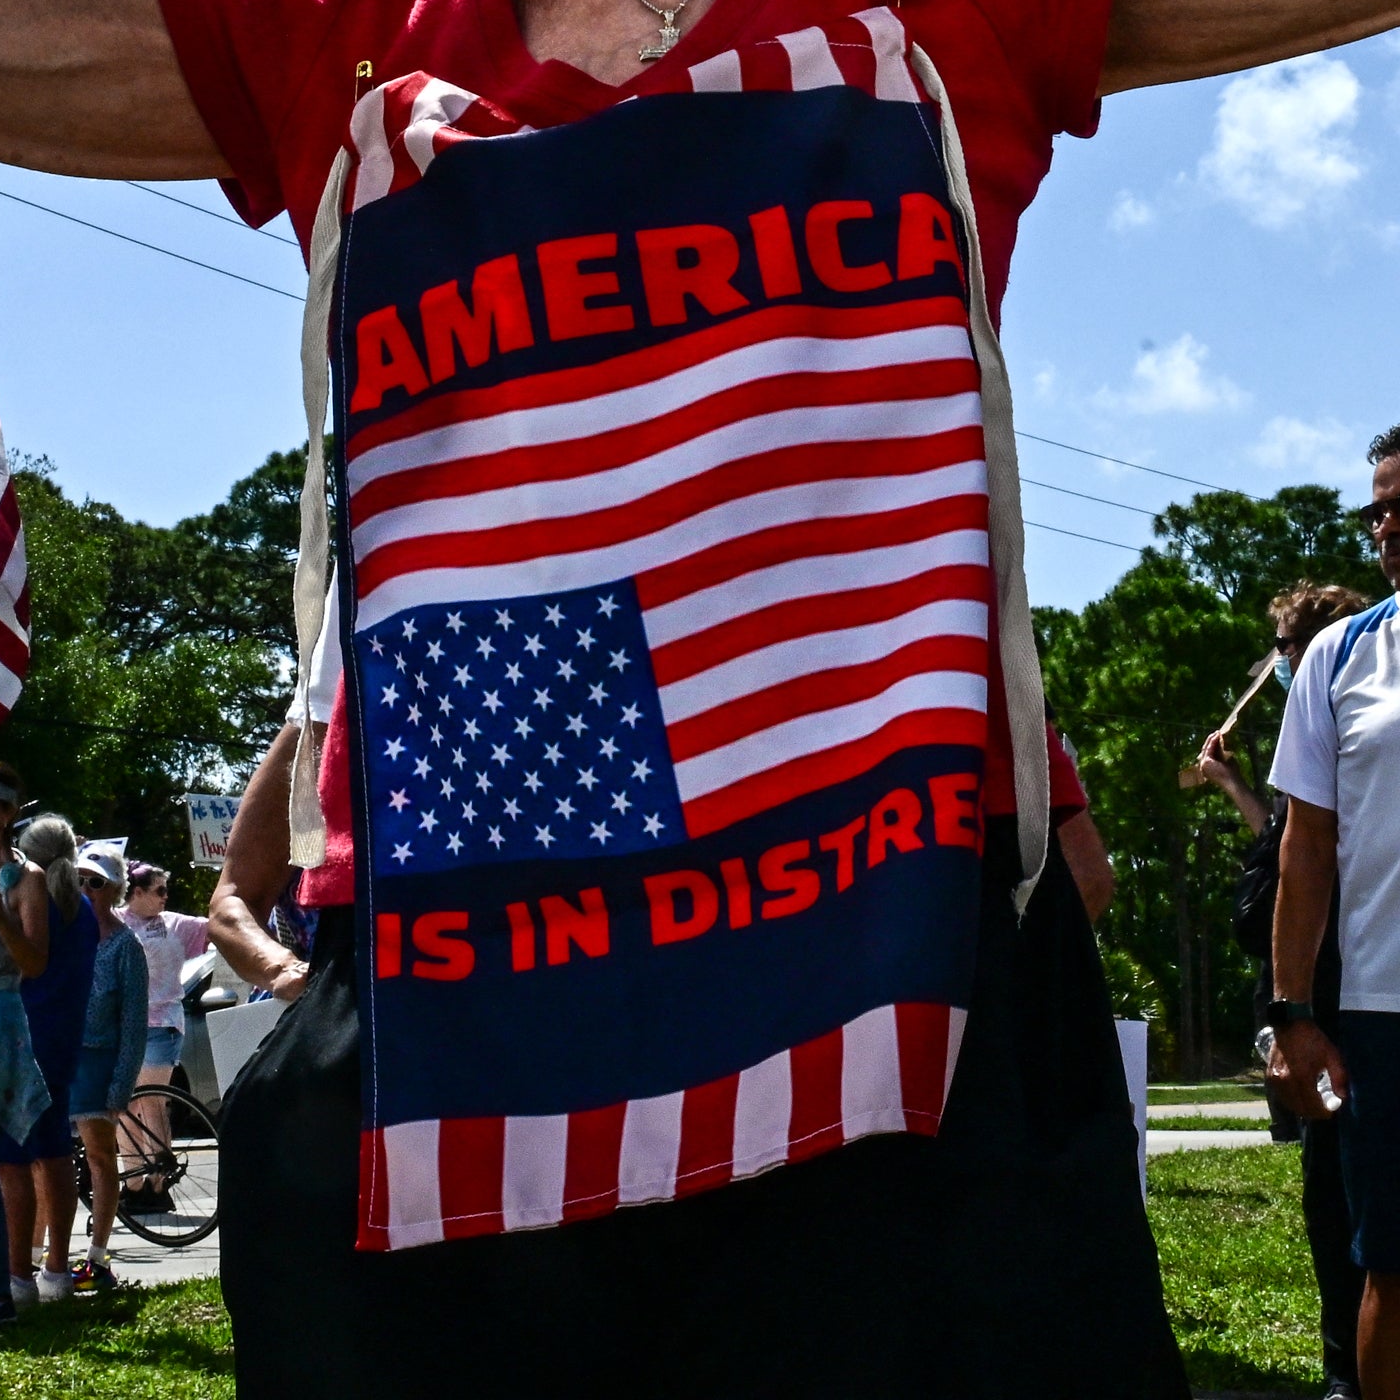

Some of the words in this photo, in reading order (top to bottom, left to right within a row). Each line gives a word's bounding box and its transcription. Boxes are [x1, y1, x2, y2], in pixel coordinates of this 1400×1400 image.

[353, 193, 961, 412] AMERICA
[378, 912, 474, 979] IS
[507, 888, 609, 971] IN
[645, 773, 985, 945] DISTRE
